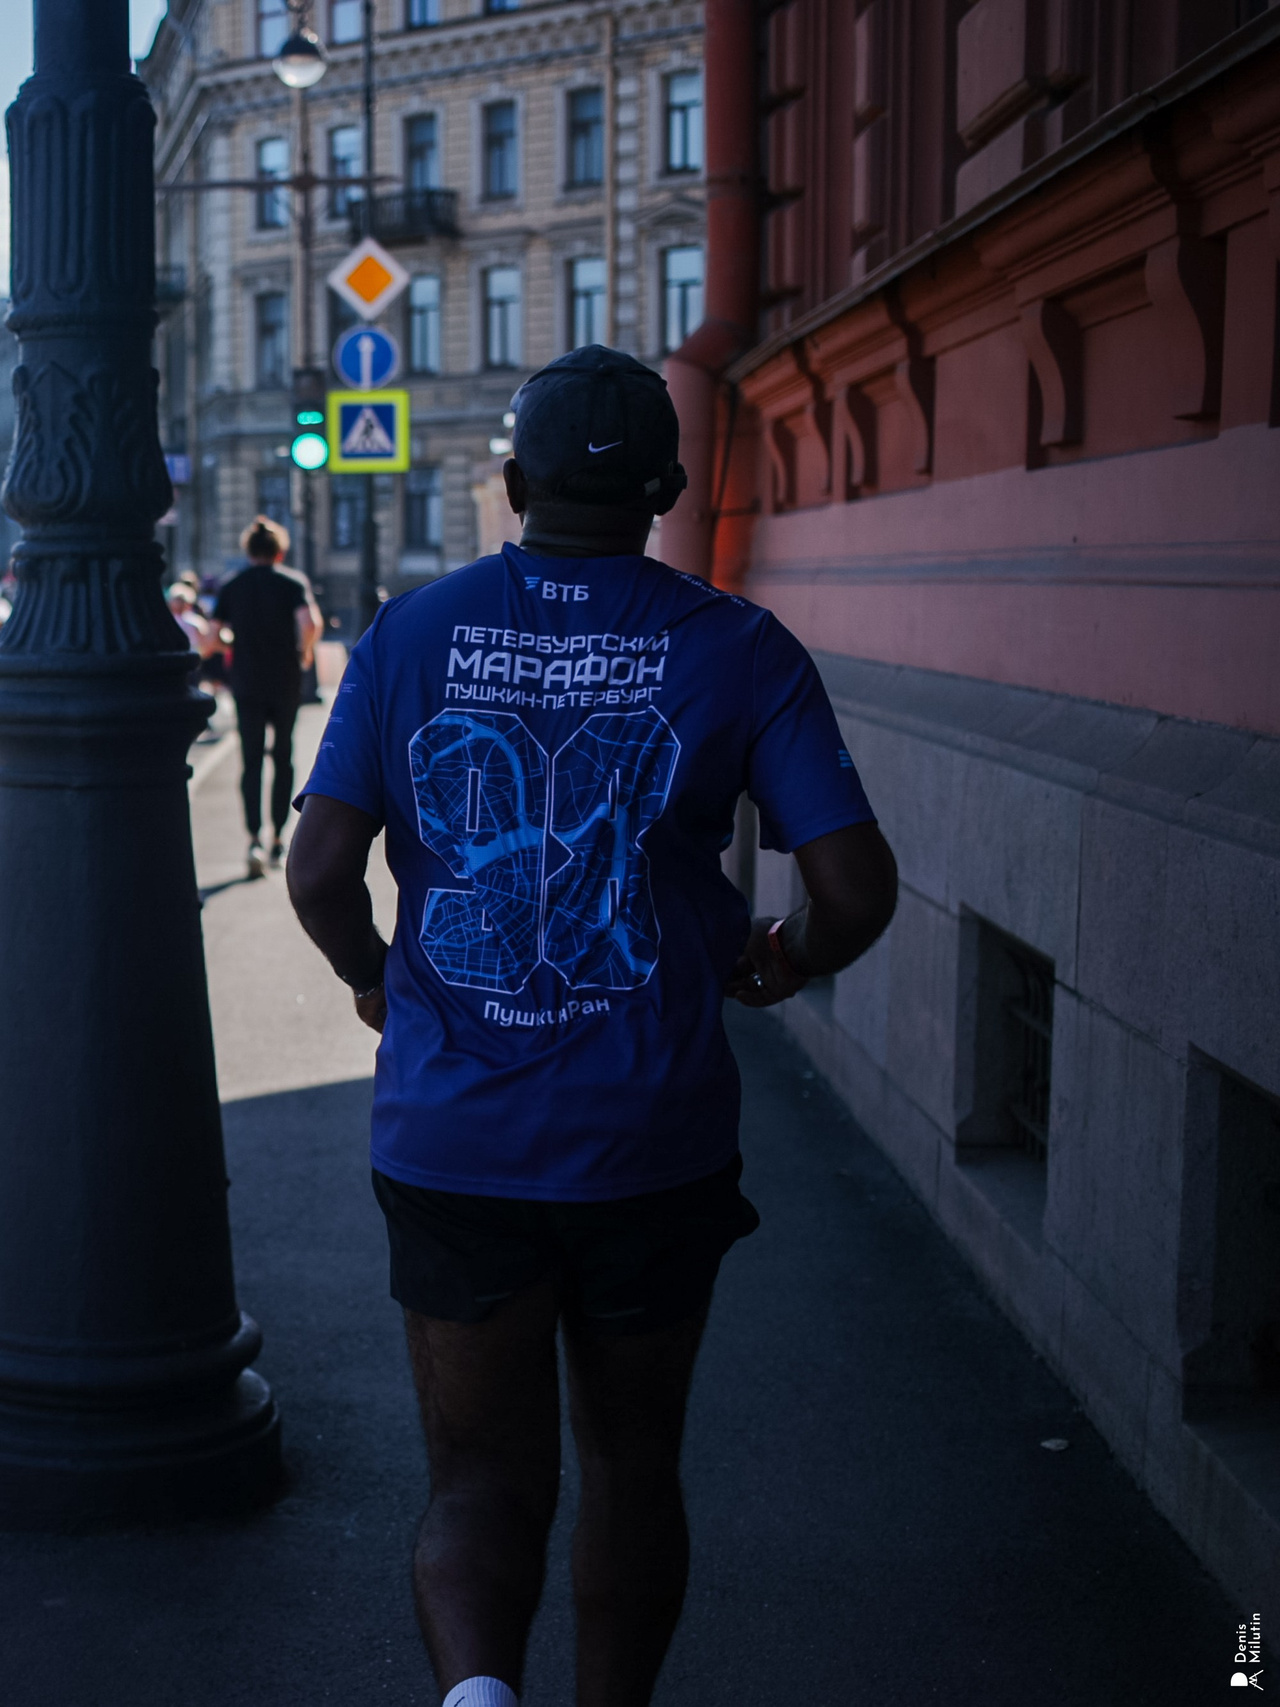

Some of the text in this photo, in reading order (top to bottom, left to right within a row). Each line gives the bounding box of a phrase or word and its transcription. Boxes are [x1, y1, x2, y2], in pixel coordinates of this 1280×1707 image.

[541, 581, 589, 602] ВТБ
[452, 625, 670, 653] ПЕТЕРБУРГСКИЙ
[447, 648, 666, 689] МАРАФОН
[445, 683, 662, 710] ПУШКИН-ПЕТЕРБУРГ
